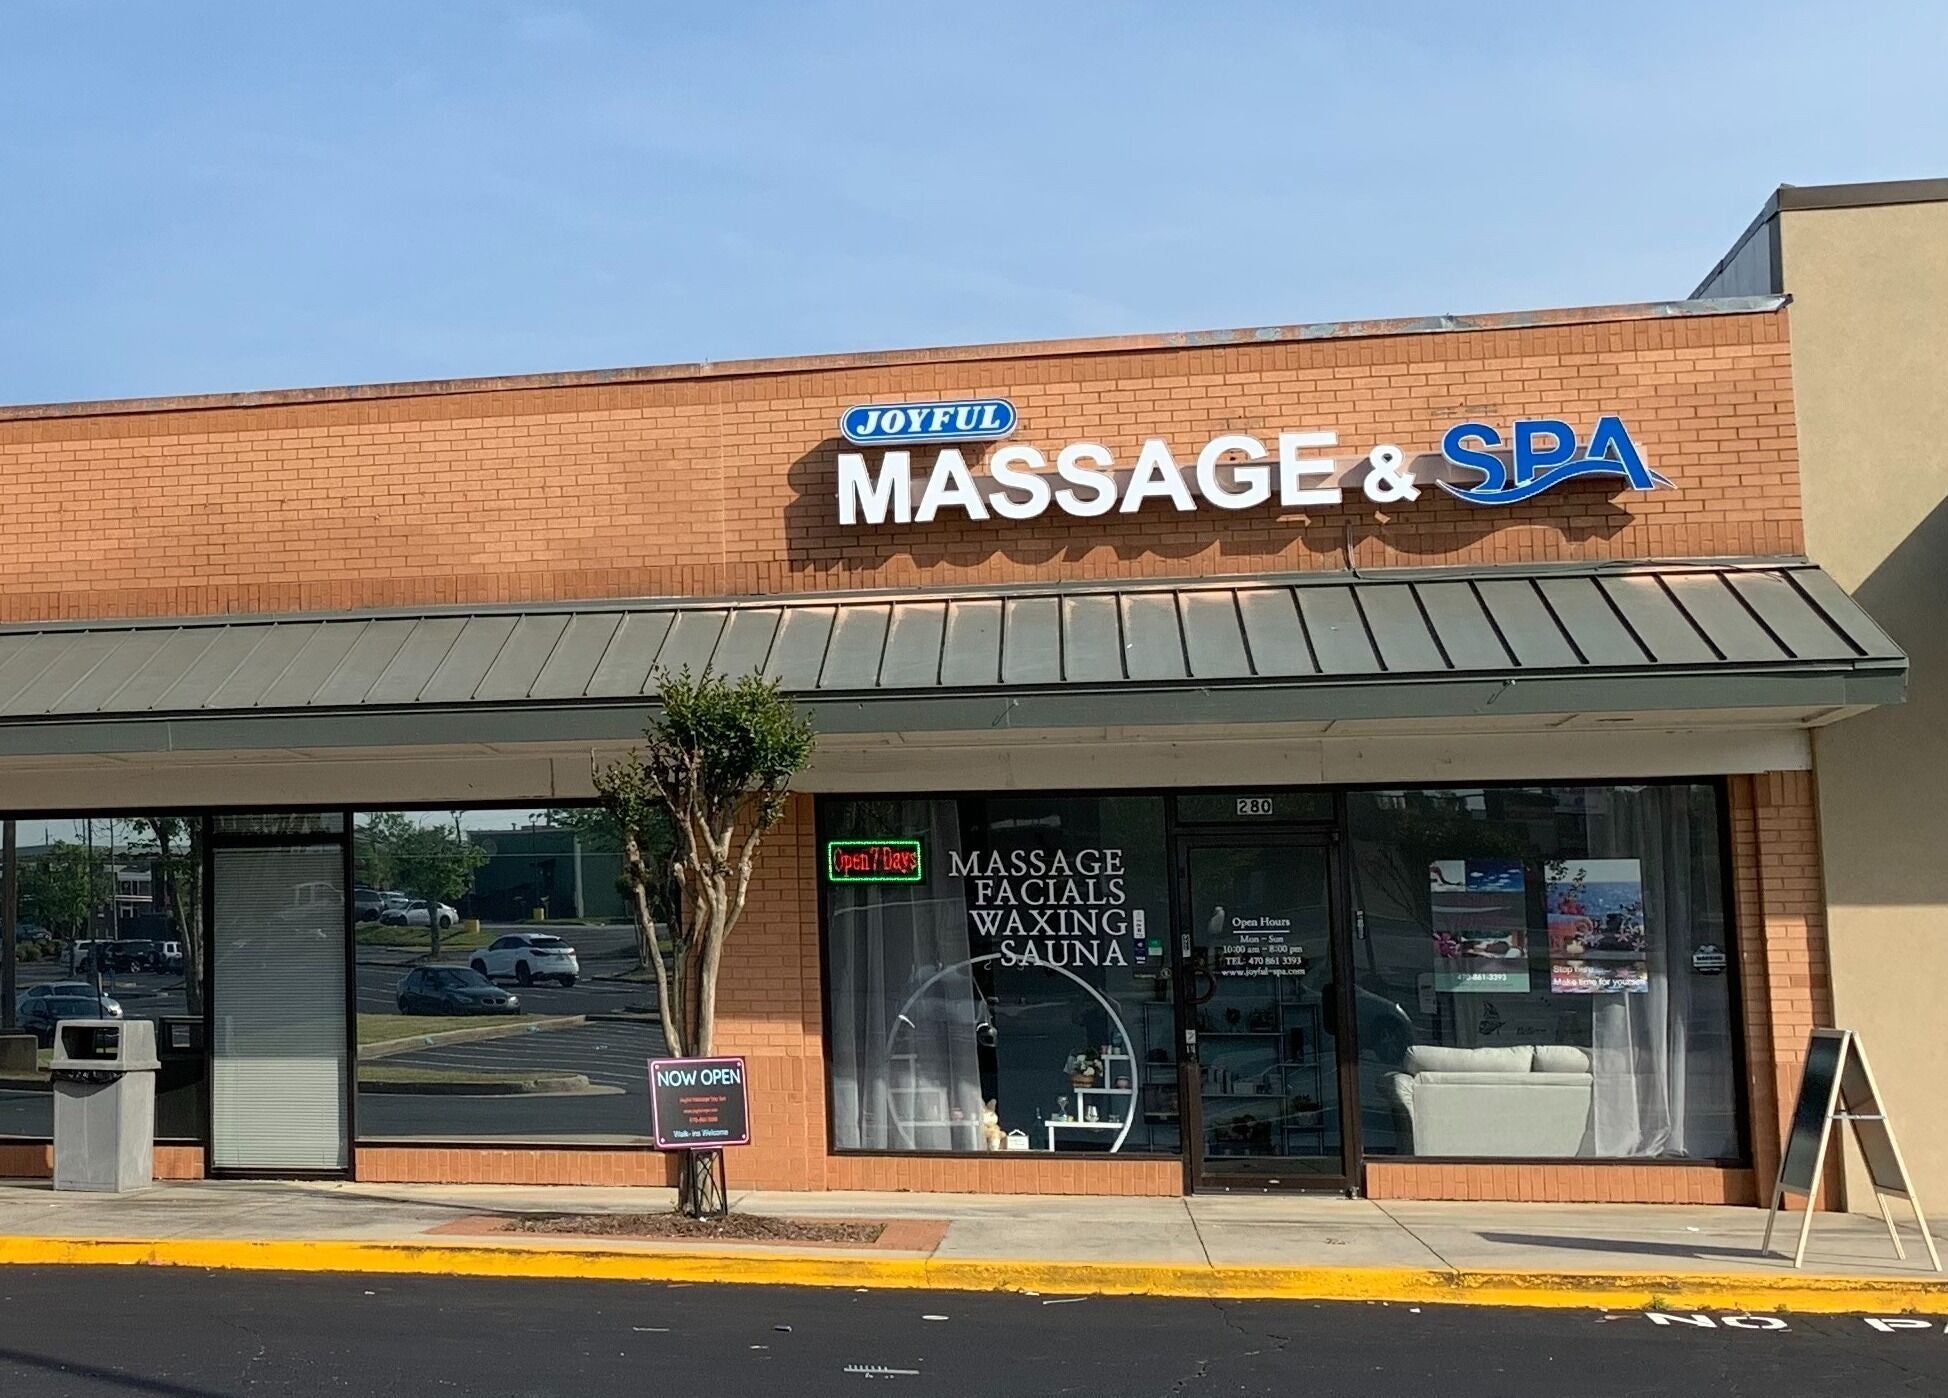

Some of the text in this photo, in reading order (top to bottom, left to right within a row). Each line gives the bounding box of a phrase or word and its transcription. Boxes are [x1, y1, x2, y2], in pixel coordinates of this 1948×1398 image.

[856, 404, 1001, 435] JOYFUL
[838, 415, 1664, 525] MASSAGE & SPA
[1238, 799, 1272, 814] 280
[833, 847, 918, 877] Open 7 Days
[948, 849, 1126, 877] MASSAGE
[974, 879, 1126, 906] FACIALS
[969, 909, 1128, 937] WAXING
[1232, 916, 1291, 929] Open Hours
[1240, 935, 1260, 943] Mon
[1268, 934, 1284, 943] Sun
[1000, 939, 1128, 967] SAUNA
[1223, 945, 1246, 954] 10:00
[1248, 956, 1264, 965] 470
[1282, 956, 1302, 965] 3393
[1553, 965, 1573, 975] Stop
[1553, 977, 1577, 986] Make
[1598, 977, 1611, 986] for
[657, 1068, 741, 1087] NOW OPEN
[1645, 1311, 1948, 1335] NO P
